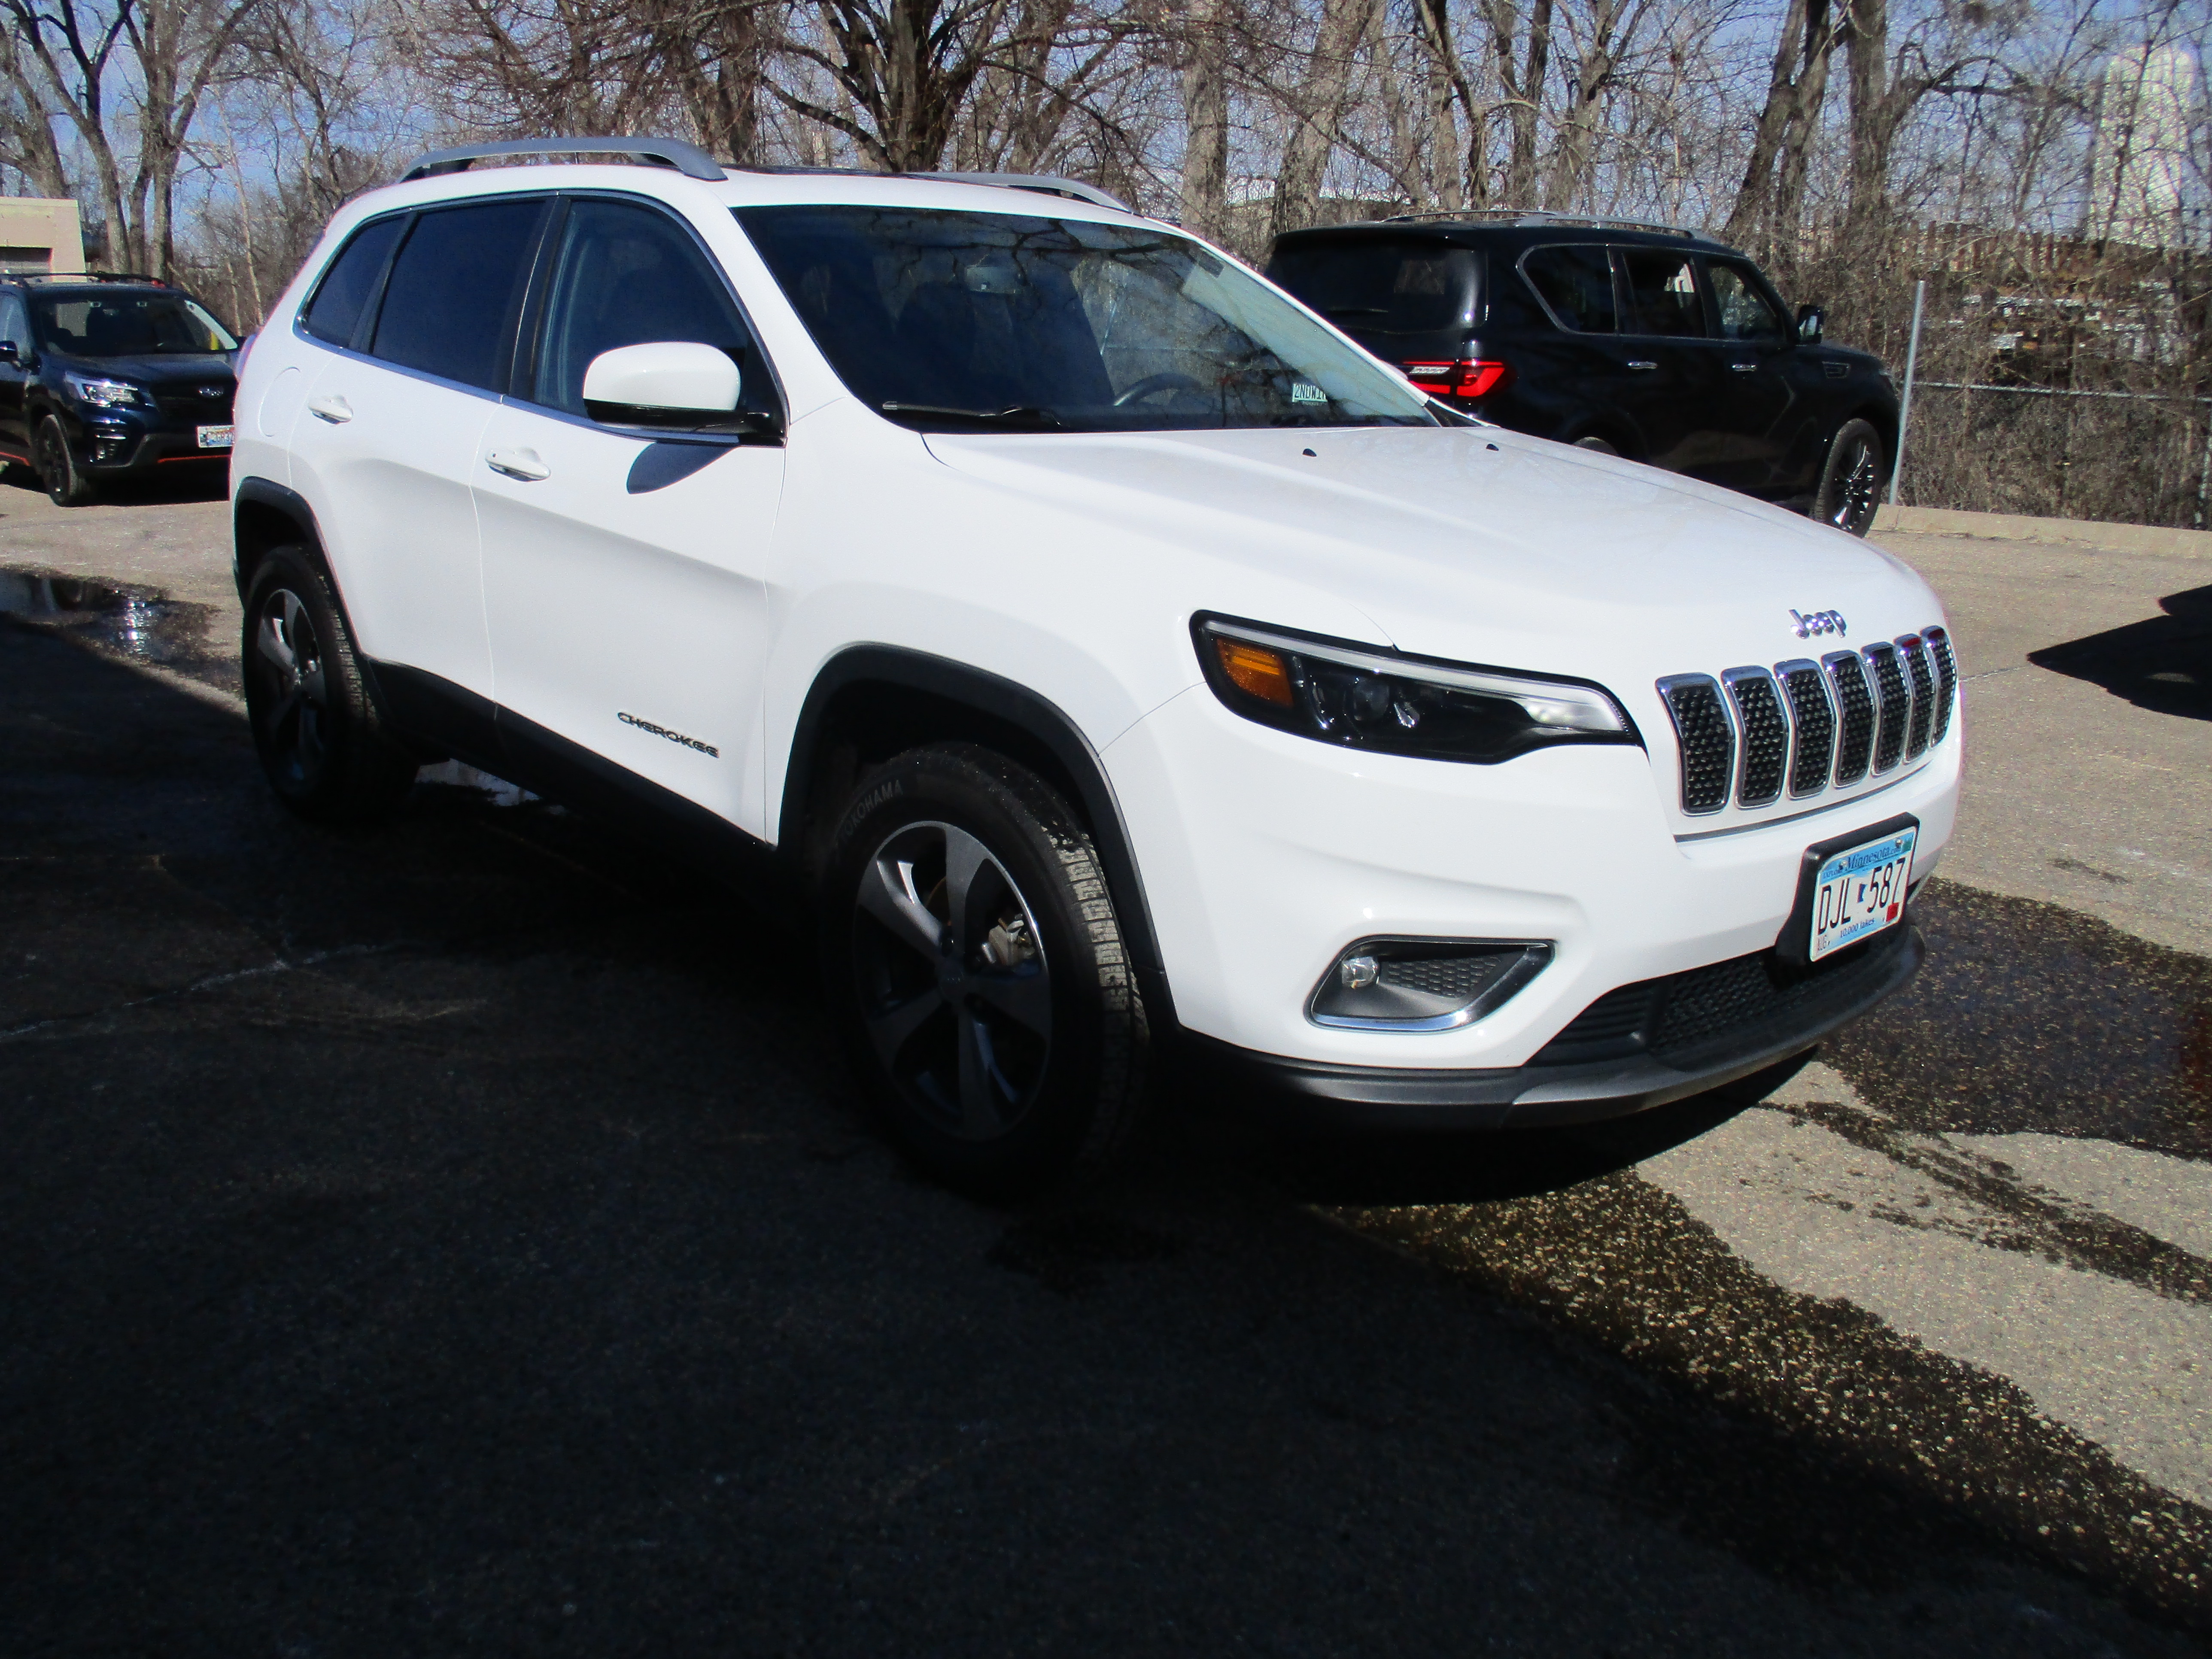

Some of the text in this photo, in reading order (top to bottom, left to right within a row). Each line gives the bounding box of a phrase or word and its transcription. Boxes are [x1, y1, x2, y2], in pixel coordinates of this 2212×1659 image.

[1788, 609, 1847, 639] Jeep
[617, 712, 720, 759] CHEROKEE
[1817, 857, 1906, 936] DJL 587
[1859, 918, 1875, 929] lakes
